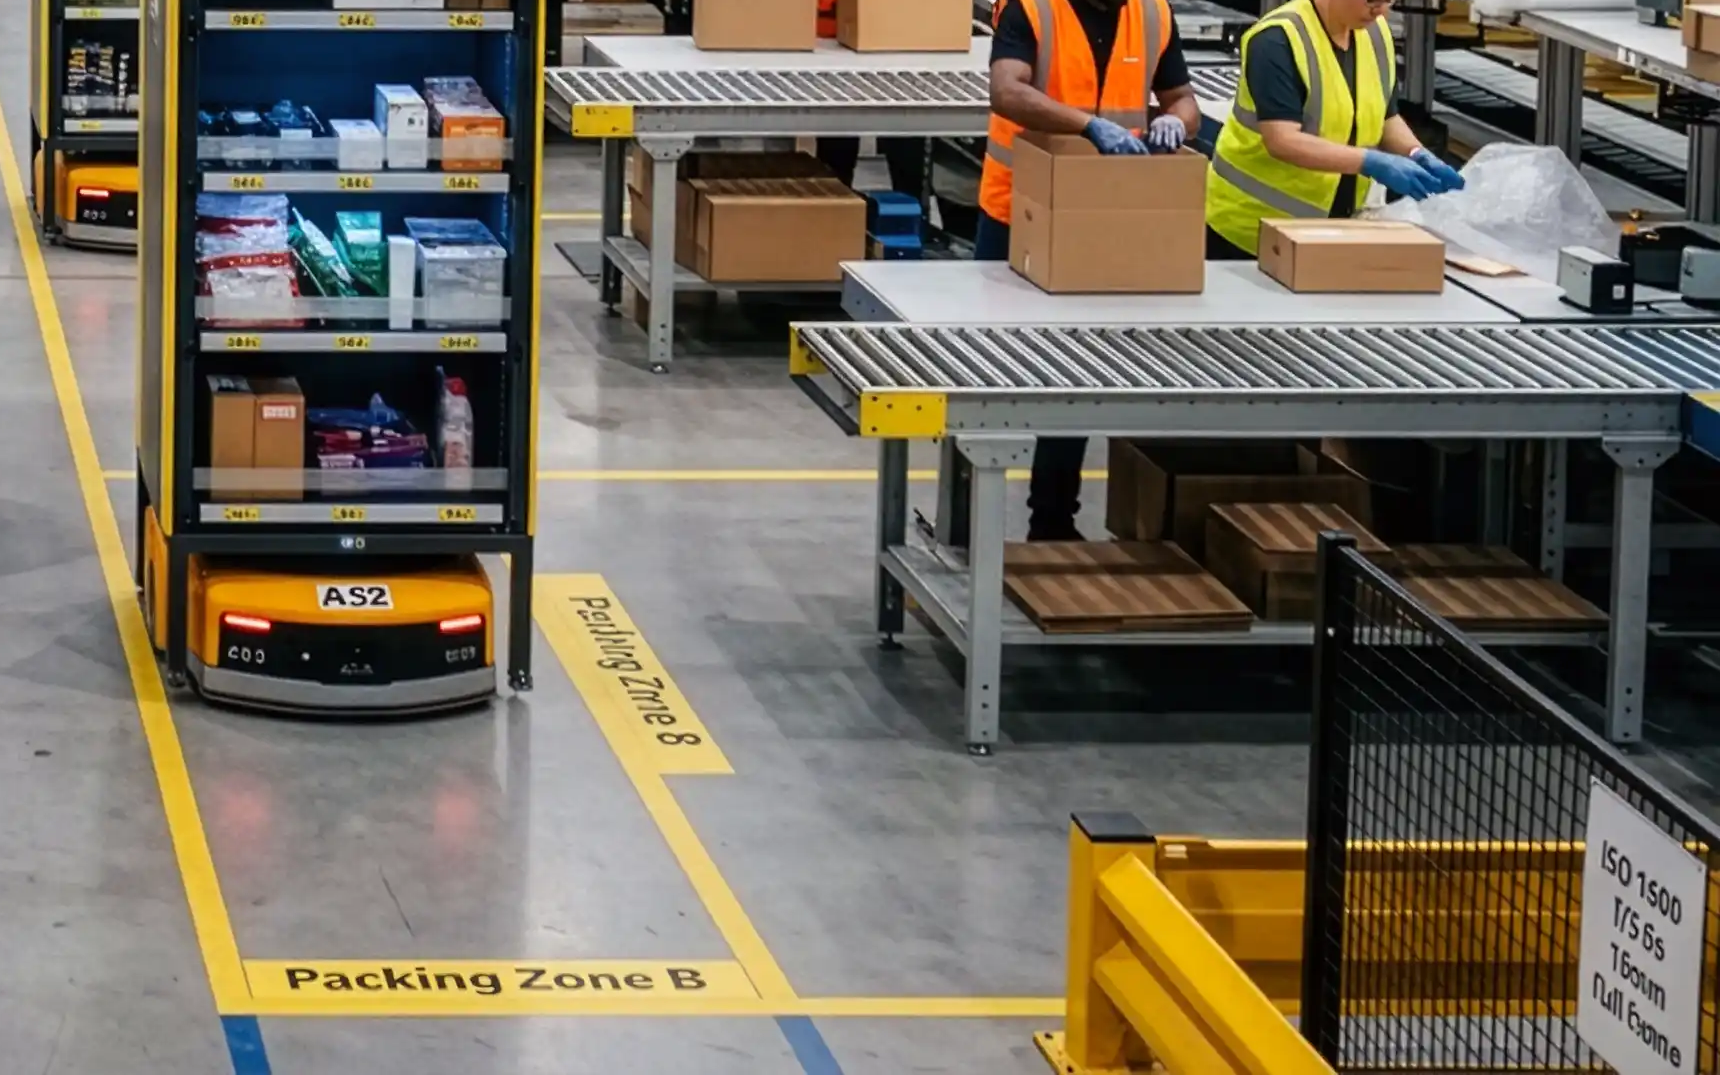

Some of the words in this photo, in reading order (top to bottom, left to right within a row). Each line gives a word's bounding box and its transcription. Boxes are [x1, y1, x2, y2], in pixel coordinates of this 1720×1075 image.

[1601, 839, 1631, 887] ISO
[284, 966, 503, 994] Packing
[513, 967, 655, 991] Zone
[666, 967, 708, 991] B
